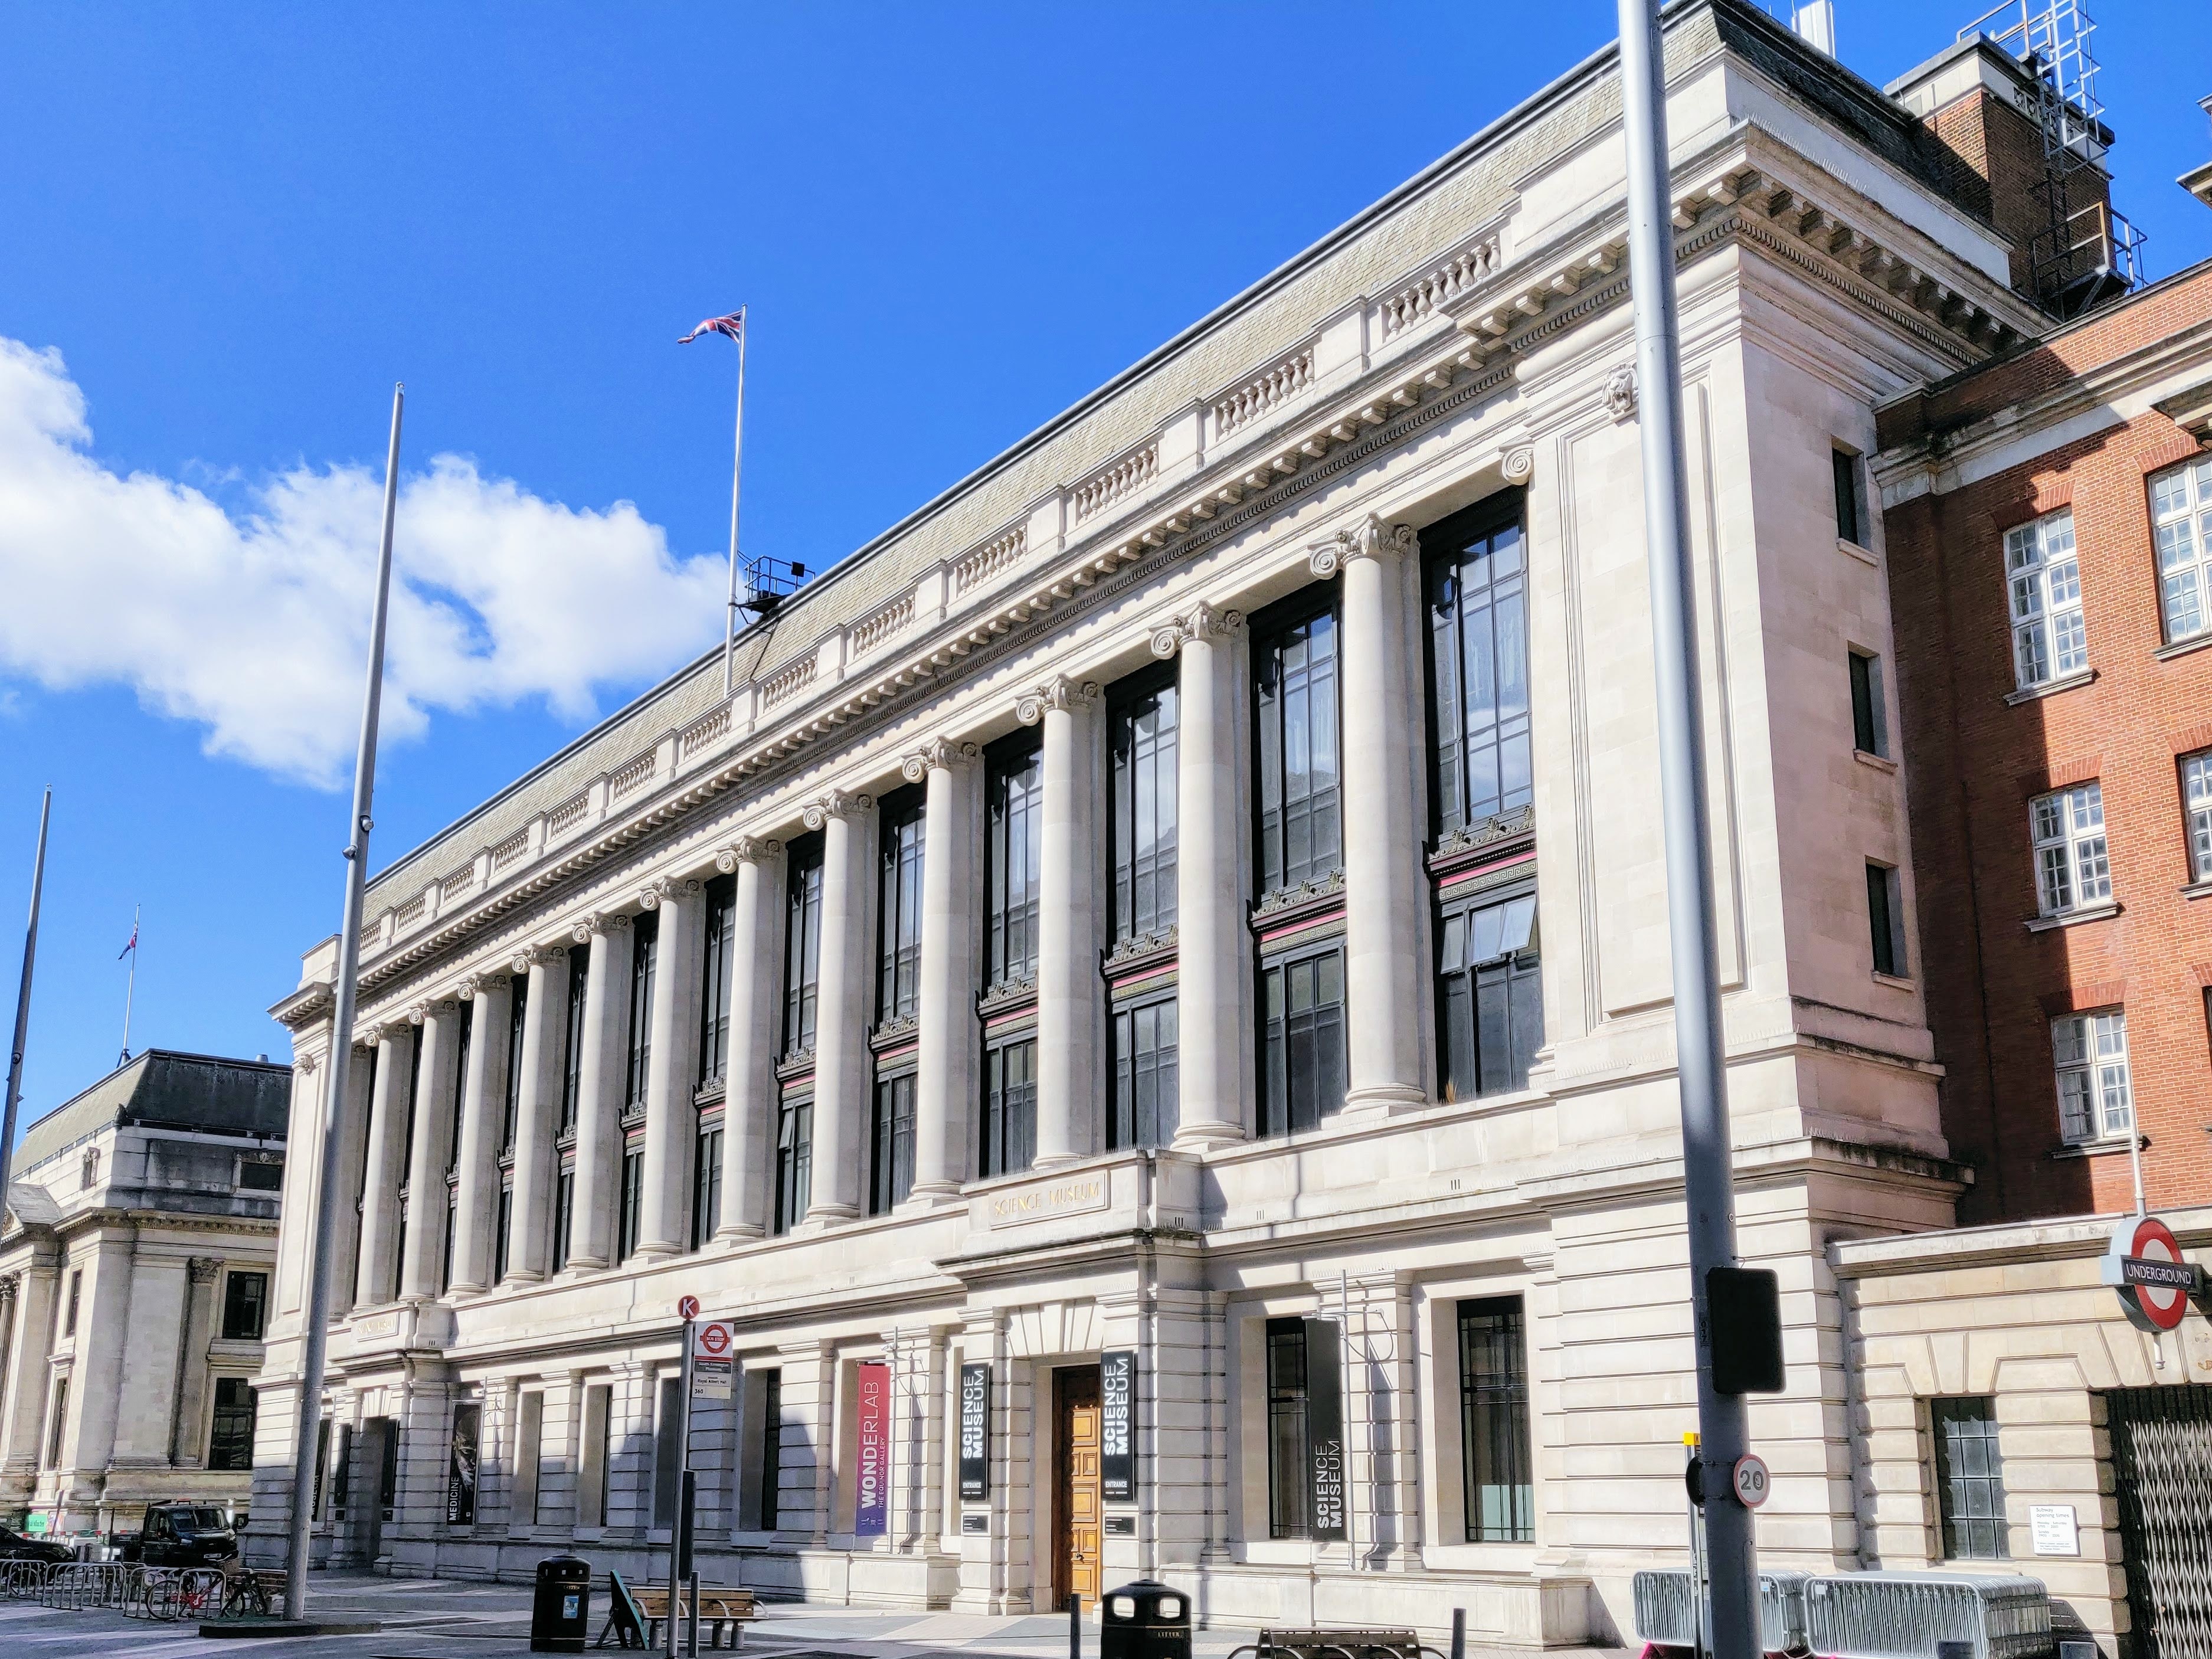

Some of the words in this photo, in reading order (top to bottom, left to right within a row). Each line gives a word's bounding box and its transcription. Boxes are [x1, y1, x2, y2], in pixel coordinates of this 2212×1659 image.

[994, 1193, 1041, 1216] SCIENCE
[1049, 1182, 1100, 1206] MUSEUM
[682, 1298, 696, 1317] K
[2126, 1264, 2191, 1284] UNDERGROUND
[862, 1382, 879, 1509] WONDERLAB
[963, 1375, 974, 1460] SCIENCE
[973, 1370, 984, 1458] MUSEUM
[1104, 1364, 1117, 1455] SCIENCE
[1116, 1359, 1128, 1455] MUSEUM
[449, 1476, 459, 1521] MEDICINE
[1315, 1444, 1329, 1529] SCIENCE
[1328, 1440, 1343, 1528] MUSEUM
[1740, 1470, 1764, 1491] 20
